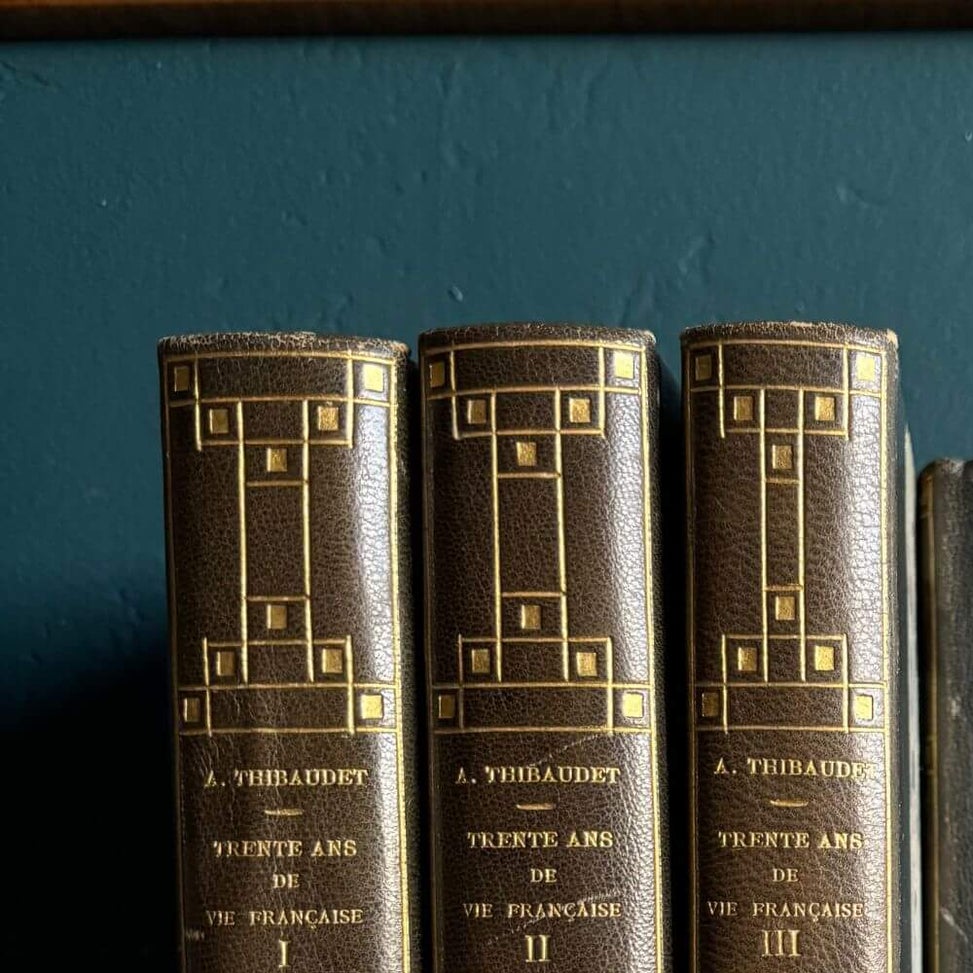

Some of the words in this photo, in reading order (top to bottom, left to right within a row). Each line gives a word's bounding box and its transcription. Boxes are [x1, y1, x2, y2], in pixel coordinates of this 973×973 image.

[455, 766, 477, 784] A.
[485, 765, 621, 784] THIBAUDET
[713, 757, 737, 775] A.
[203, 769, 226, 788] A.
[234, 768, 369, 787] THIBAUDET
[213, 840, 303, 858] TRENTE
[311, 839, 358, 857] ANS
[467, 831, 558, 849] TRENTE
[566, 830, 614, 848] ANS
[717, 830, 810, 849] TRENTE
[817, 832, 865, 850] ANS
[273, 873, 300, 889] DE
[529, 868, 558, 883] DE
[772, 868, 800, 883] DE
[205, 910, 236, 926] VIE
[249, 909, 365, 930] FRANÇAISE
[463, 902, 494, 918] VIE
[507, 902, 622, 922] FRANÇAISE
[707, 901, 739, 916] VIE
[752, 901, 865, 923] FRANÇAISE
[524, 934, 551, 963] II
[761, 928, 801, 957] III
[278, 939, 290, 969] I
